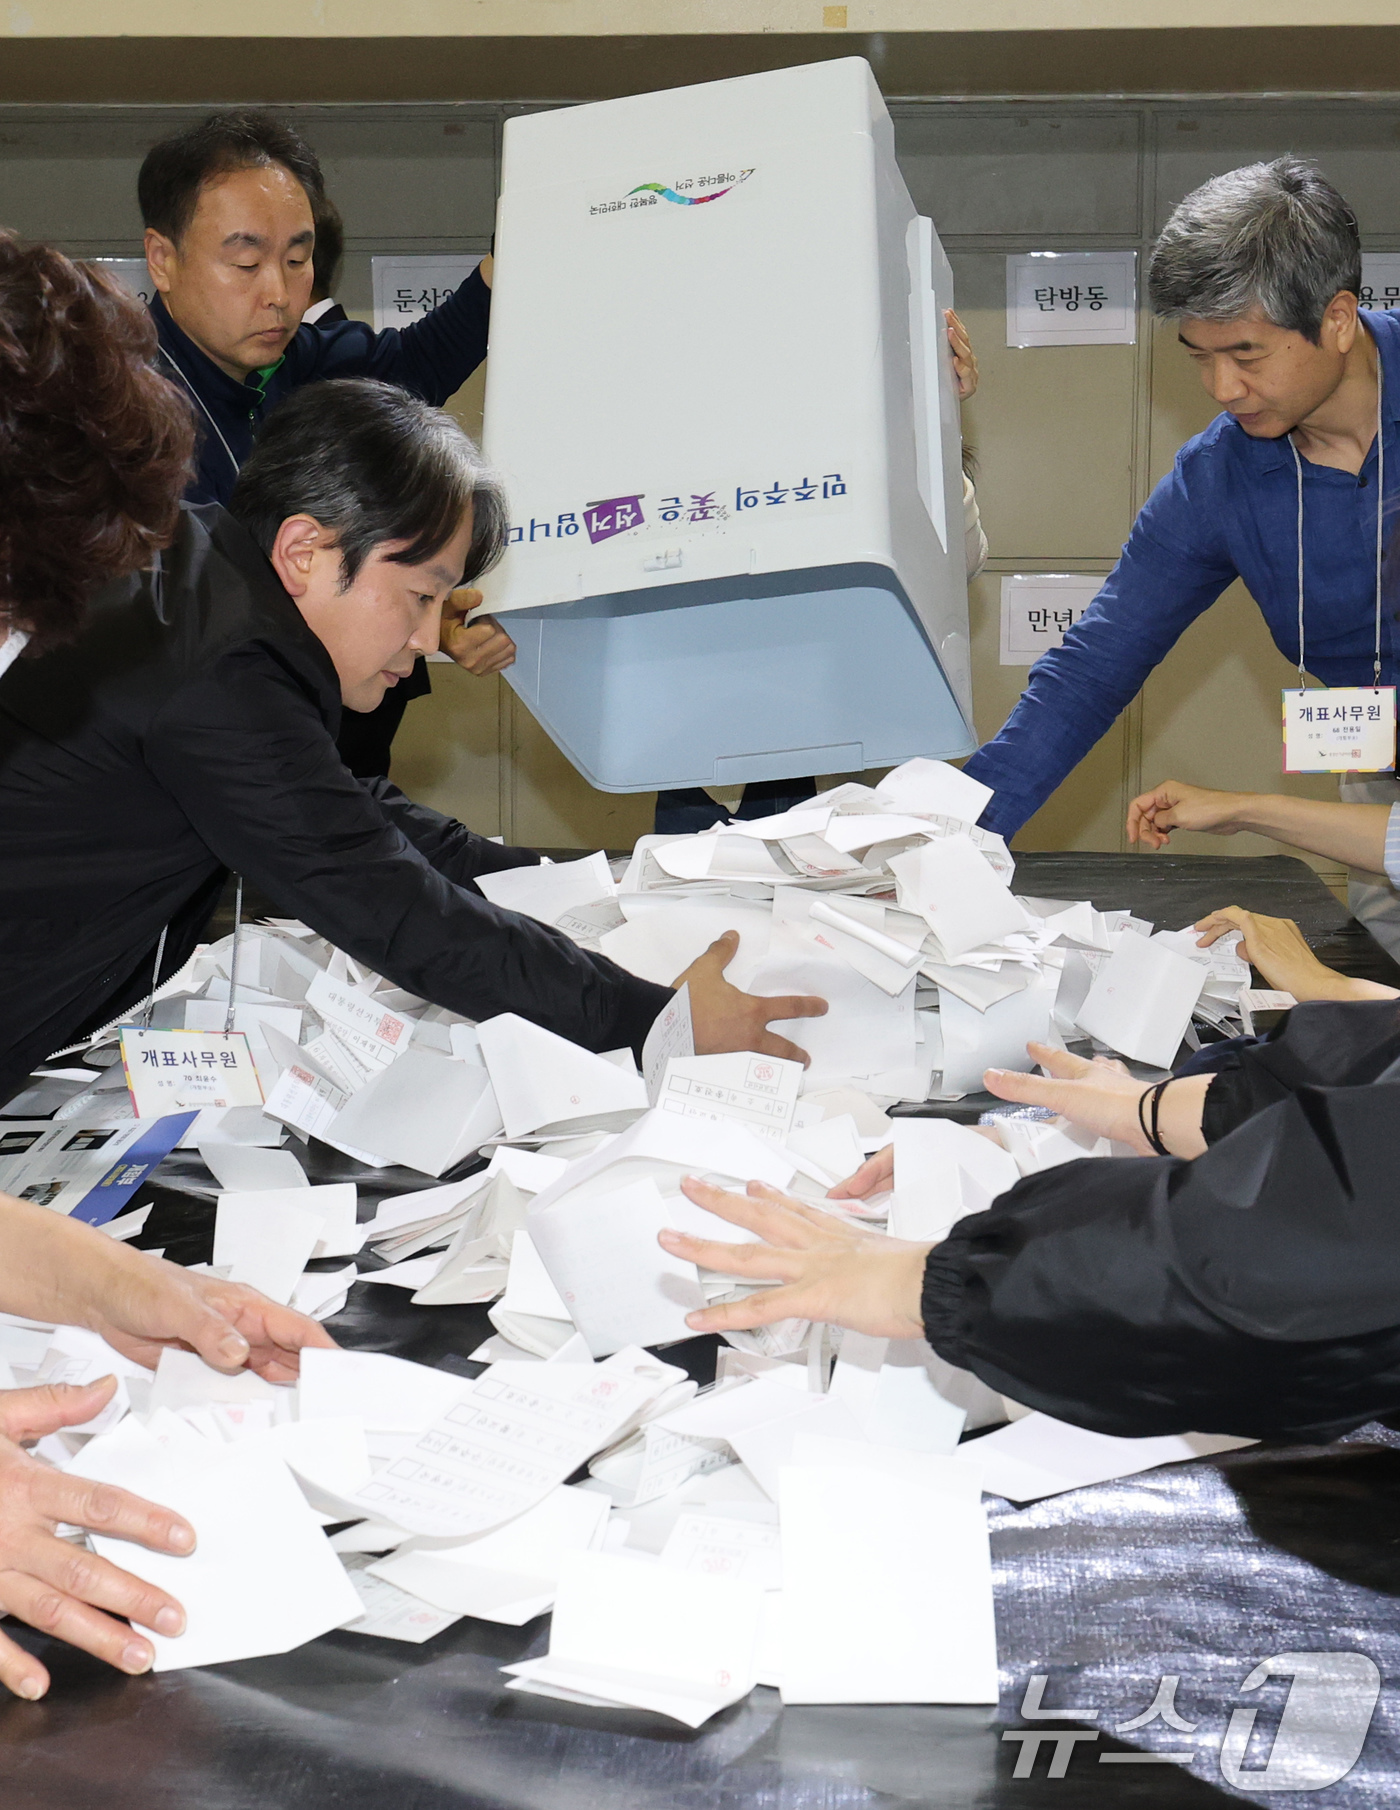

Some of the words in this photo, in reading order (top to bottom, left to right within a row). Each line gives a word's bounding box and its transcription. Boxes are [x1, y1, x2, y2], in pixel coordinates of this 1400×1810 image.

[676, 179, 694, 191] 선거
[698, 173, 736, 187] 아름다운
[589, 202, 627, 215] 대한민국
[630, 195, 658, 209] 행복한
[1034, 286, 1109, 312] 탄방동
[736, 473, 847, 511] 민주주의
[658, 491, 717, 522] 꽃은
[1028, 608, 1086, 633] 만년
[1299, 705, 1381, 722] 개표사무원
[328, 992, 389, 1031] 대통령선거투
[141, 1049, 238, 1068] 개표사무원
